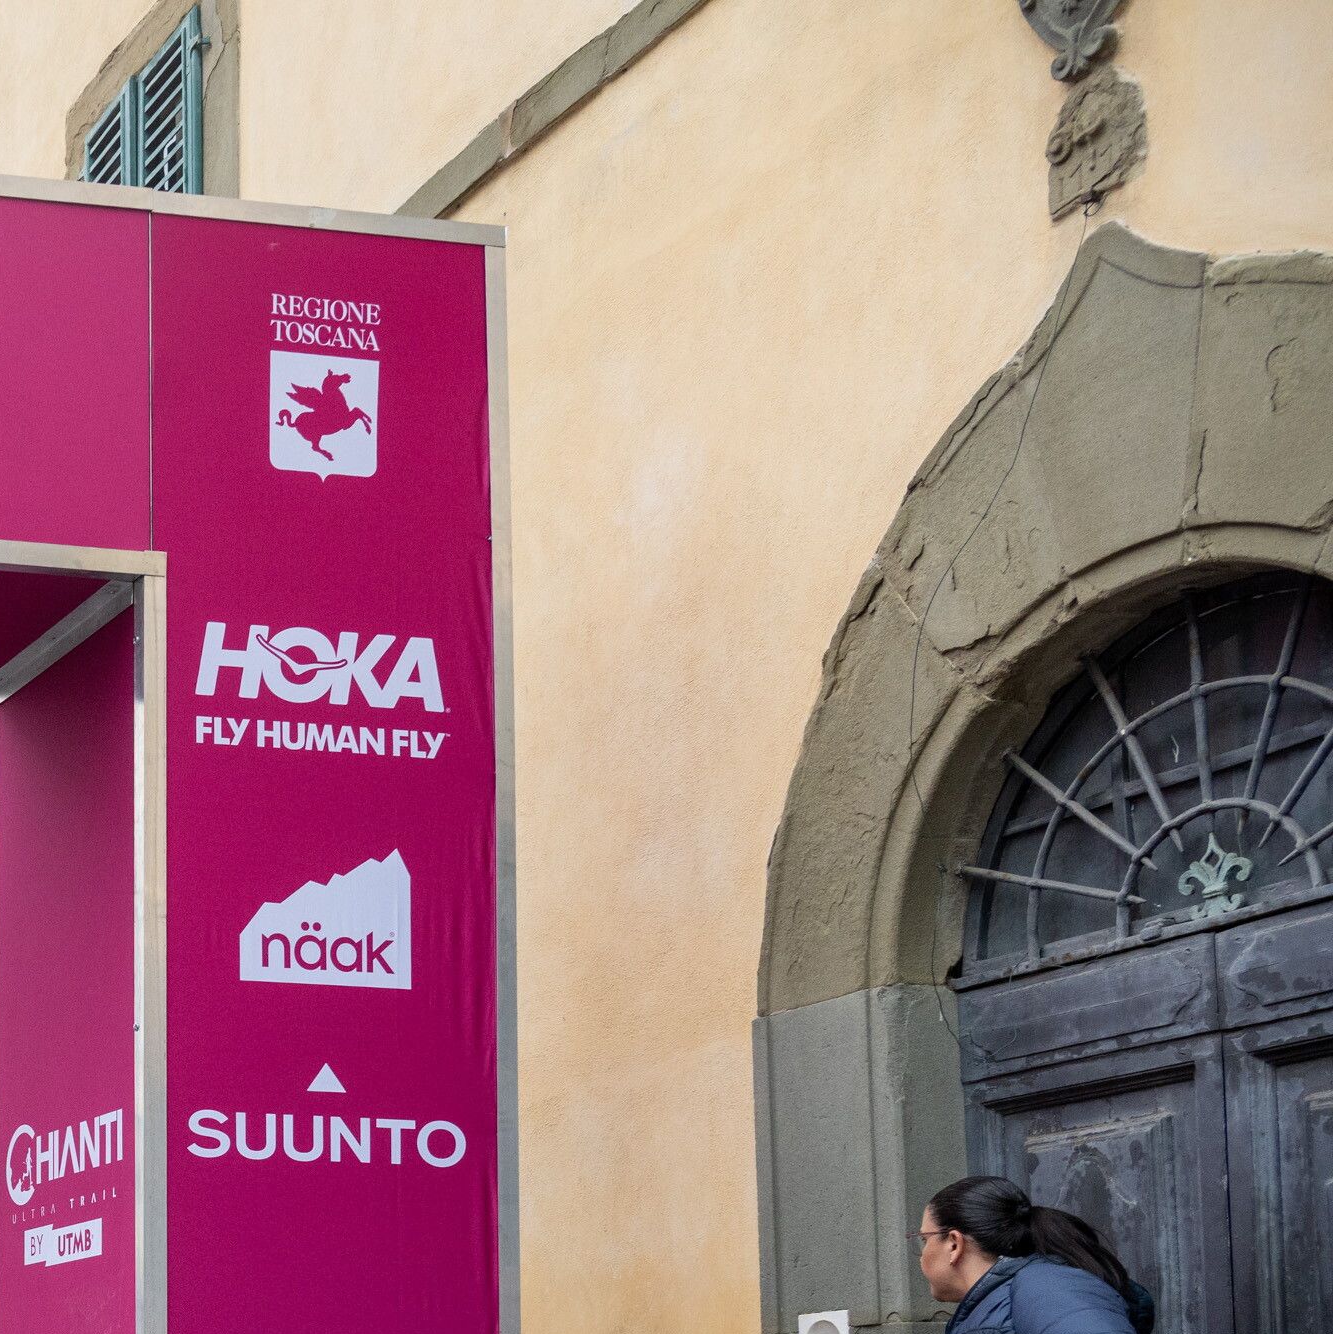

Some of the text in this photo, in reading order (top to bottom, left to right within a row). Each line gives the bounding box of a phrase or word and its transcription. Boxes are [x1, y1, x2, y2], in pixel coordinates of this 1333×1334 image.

[271, 292, 381, 325] REGIONE
[271, 320, 380, 352] TOSCANA
[195, 716, 246, 746] FLY
[256, 719, 385, 757] HUMAN
[261, 921, 395, 975] näak
[6, 1108, 123, 1206] CHIANTI
[187, 1109, 467, 1168] SUUNTO
[12, 1187, 116, 1224] ULTRA TRAIL
[30, 1228, 92, 1257] BY UTMB
